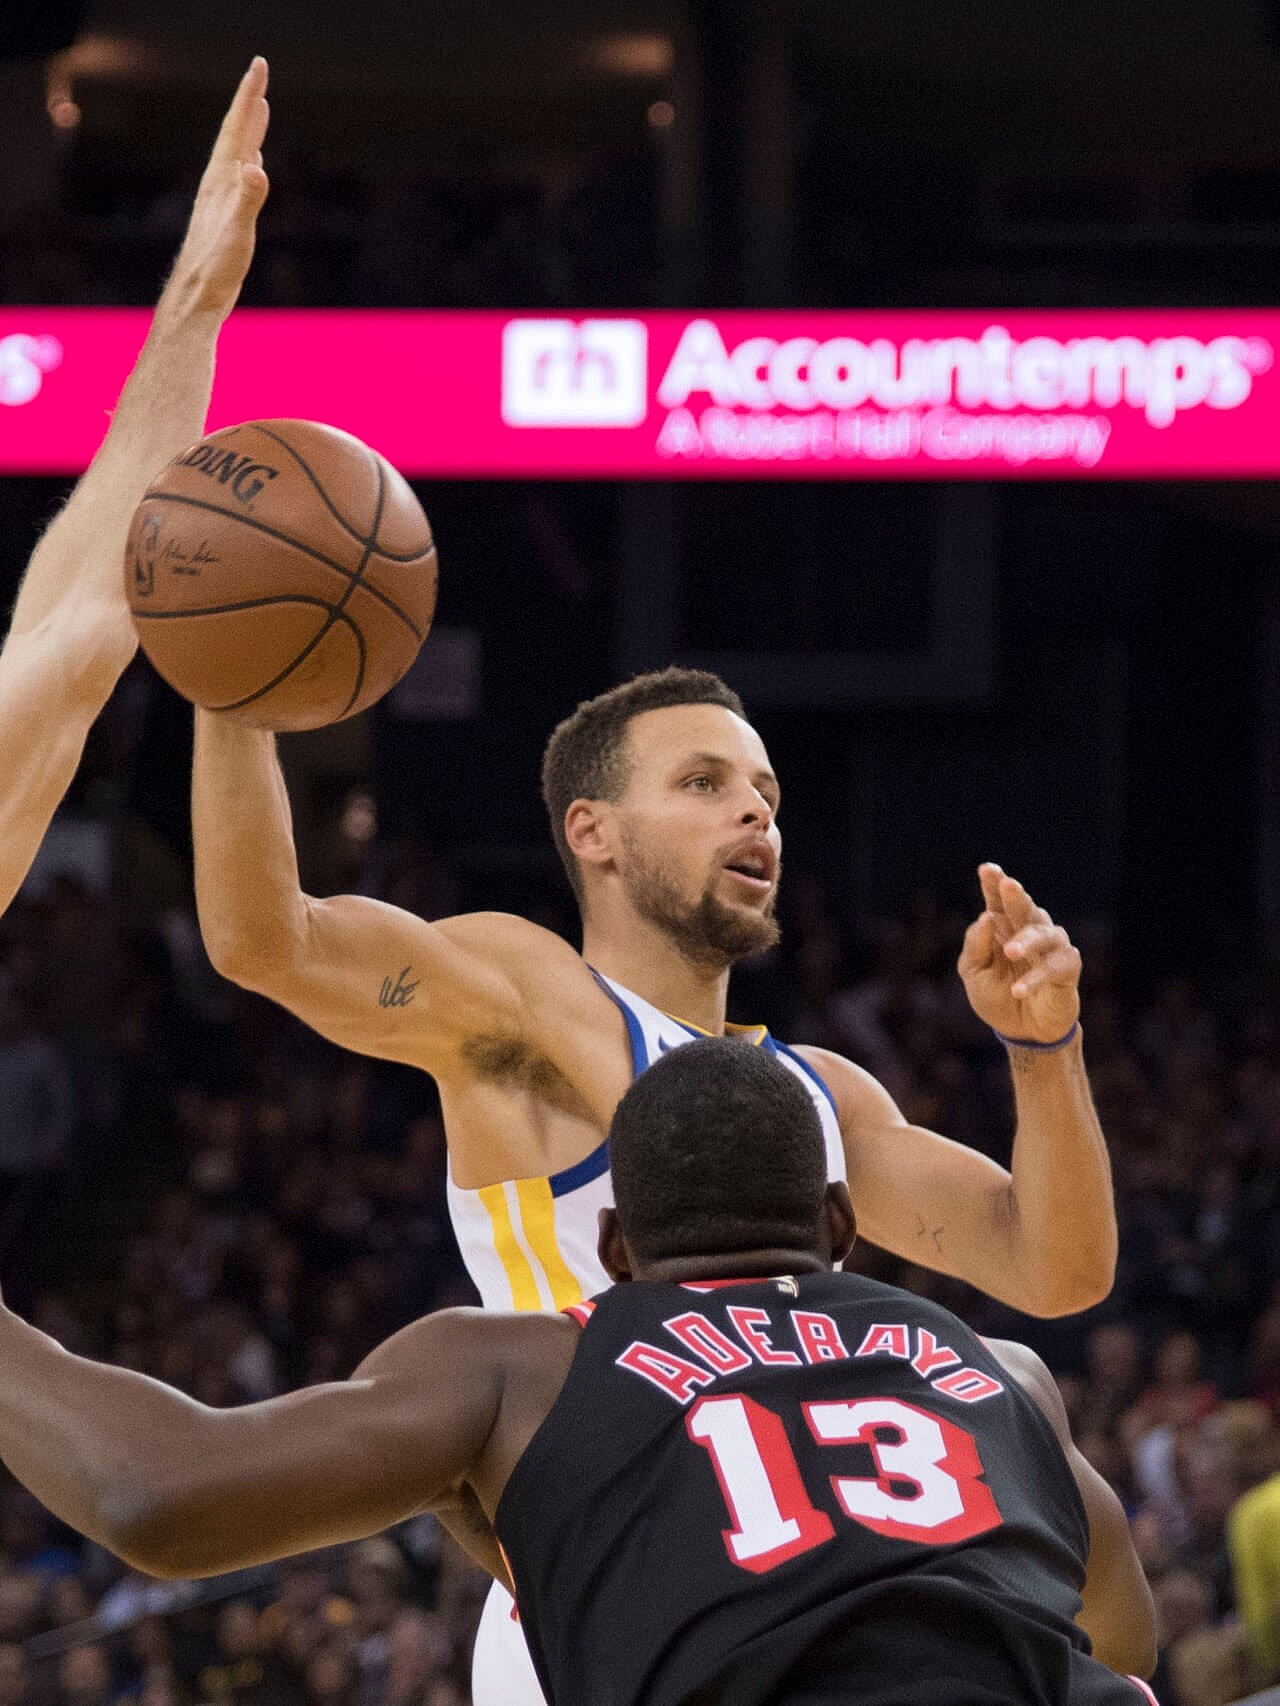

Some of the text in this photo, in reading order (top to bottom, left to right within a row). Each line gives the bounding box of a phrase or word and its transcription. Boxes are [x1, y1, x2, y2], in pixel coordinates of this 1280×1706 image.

[658, 318, 1252, 428] Accountemps
[173, 445, 278, 503] DING
[656, 407, 703, 459] A
[616, 1305, 1004, 1405] ADEBAYO
[684, 1392, 1005, 1575] 13
